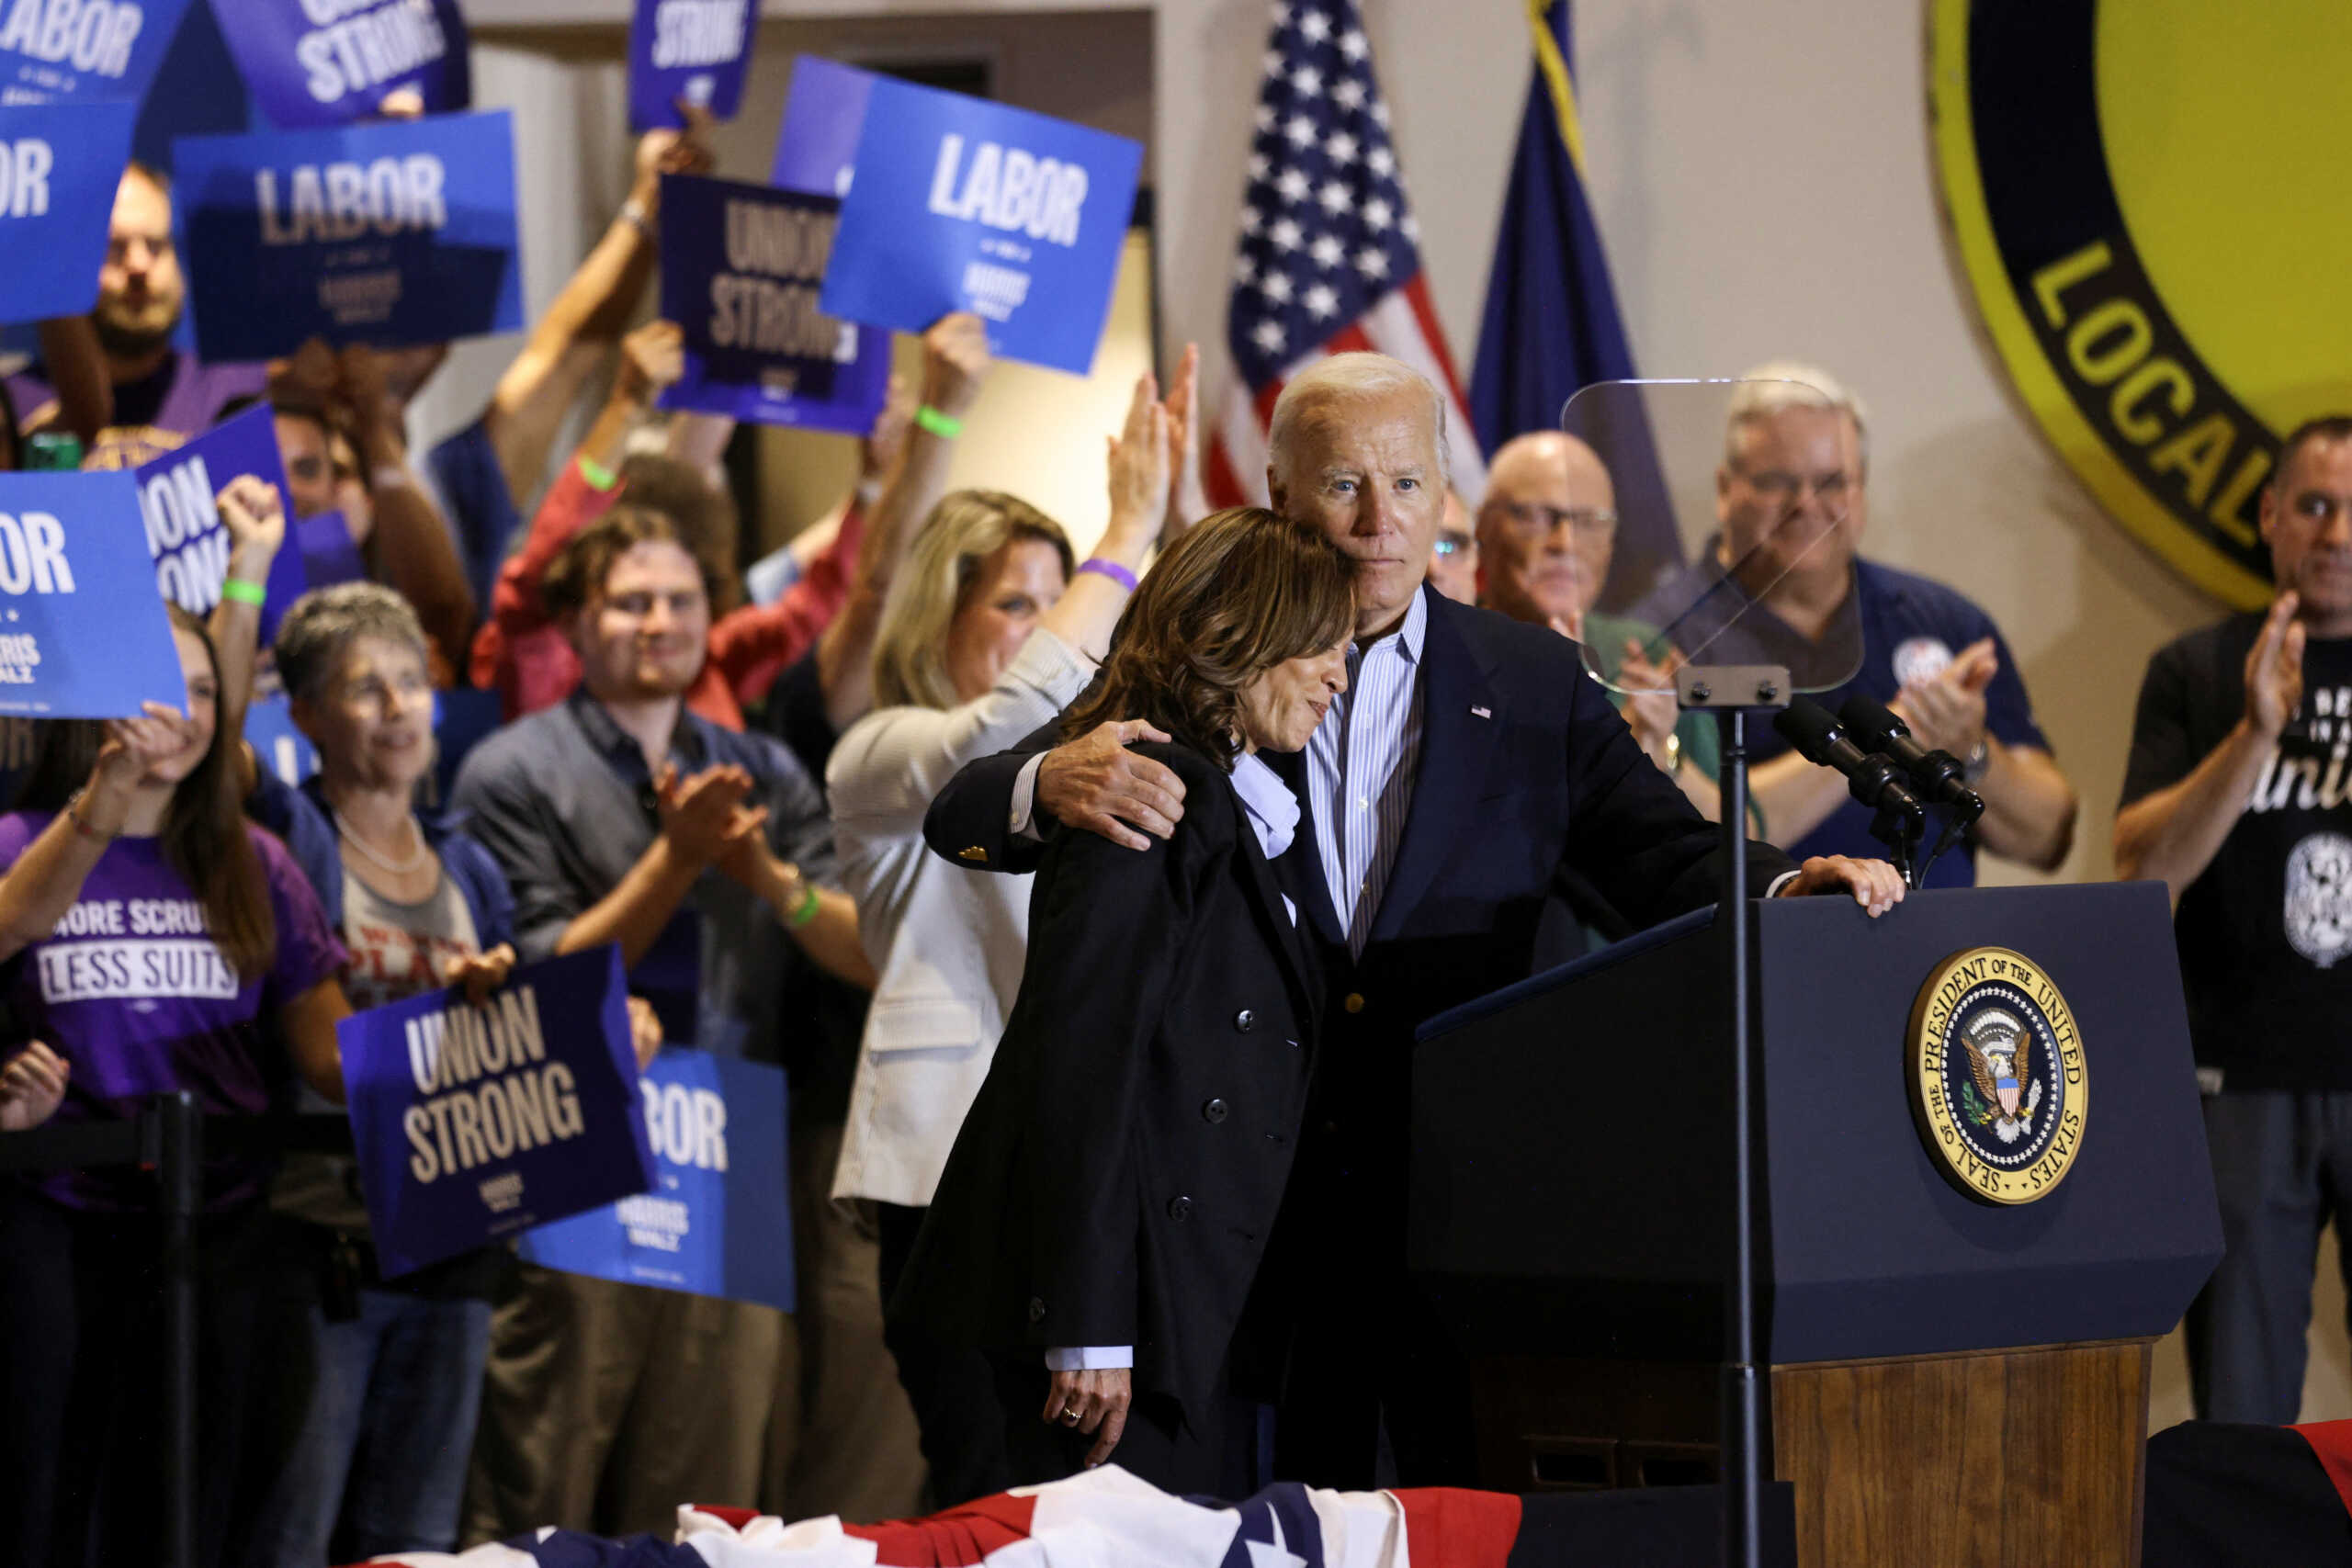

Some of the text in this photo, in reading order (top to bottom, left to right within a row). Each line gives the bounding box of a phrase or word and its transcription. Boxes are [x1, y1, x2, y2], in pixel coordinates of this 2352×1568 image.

[254, 152, 448, 246] LABOR
[927, 131, 1090, 248] LABOR
[2031, 240, 2271, 547] LOCAL
[47, 949, 130, 996] LESS
[403, 985, 547, 1095] UNION
[1925, 957, 2081, 1192] SEAL OF THE PRESIDENT OF THE UNITED STATES
[402, 1061, 585, 1184] STRONG
